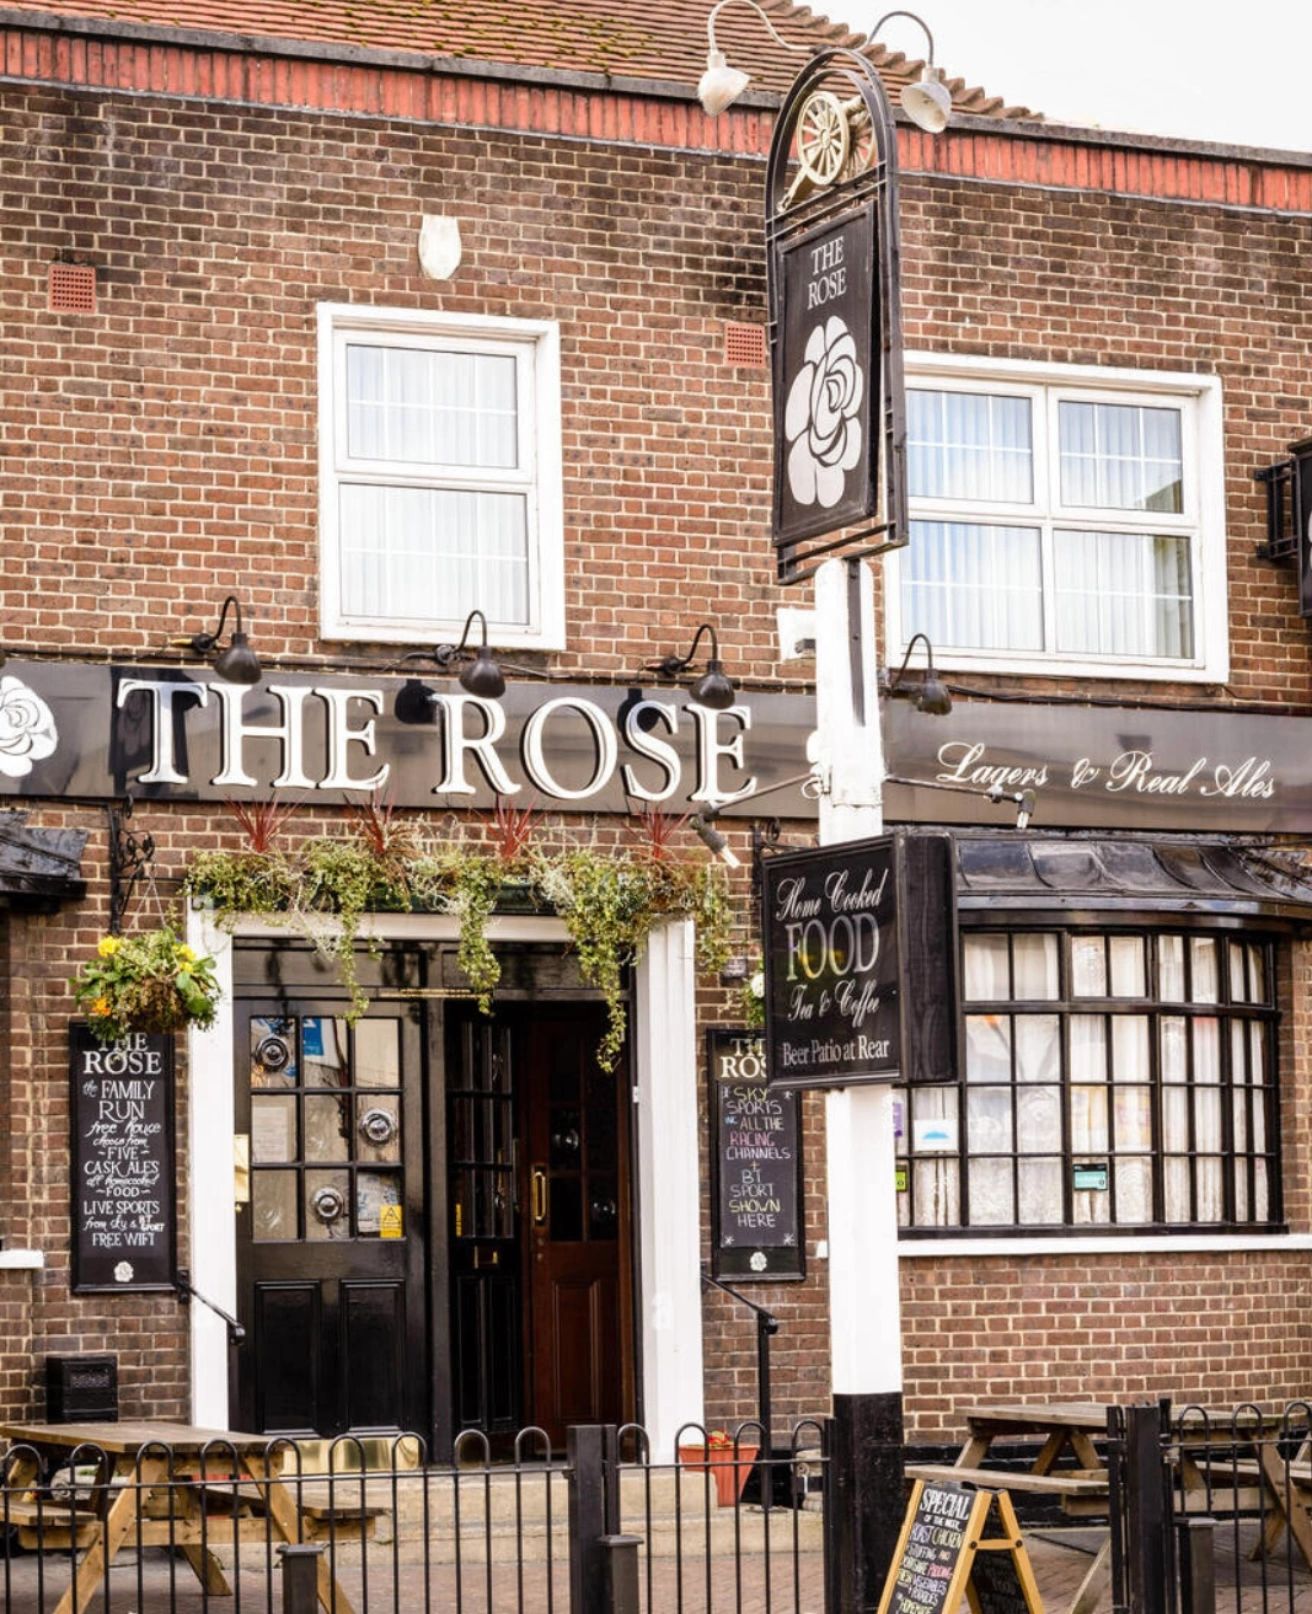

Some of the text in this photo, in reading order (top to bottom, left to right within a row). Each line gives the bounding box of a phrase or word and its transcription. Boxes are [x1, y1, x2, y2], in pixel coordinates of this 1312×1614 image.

[811, 236, 844, 275] THE
[807, 267, 846, 309] ROSE
[117, 676, 758, 801] THE ROSE
[1071, 757, 1098, 789] &
[1105, 749, 1206, 795] Real
[1200, 756, 1276, 799] Ales
[776, 868, 889, 921] Home Cooked
[785, 912, 880, 982] FOOD
[787, 978, 880, 1028] Tea & Coffee
[782, 1034, 890, 1066] Beer Patio at Rear
[82, 1050, 162, 1075] ROSE
[101, 1080, 155, 1100] FAMILY
[98, 1099, 145, 1124] RUN
[726, 1099, 783, 1115] SPORTS
[740, 1116, 761, 1131] ALL
[762, 1116, 785, 1131] THE
[729, 1131, 776, 1147] RACING
[726, 1146, 791, 1161] CHANNELS
[83, 1161, 160, 1178] CASK ALES
[741, 1169, 762, 1184] BT
[106, 1186, 140, 1197] FOOD
[730, 1183, 774, 1197] SPORT
[83, 1200, 161, 1215] LIVE SPORTS
[728, 1199, 781, 1213] SHOWN
[737, 1213, 776, 1228] HERE
[92, 1233, 122, 1247] FREE
[920, 1489, 970, 1520] SPECIAL
